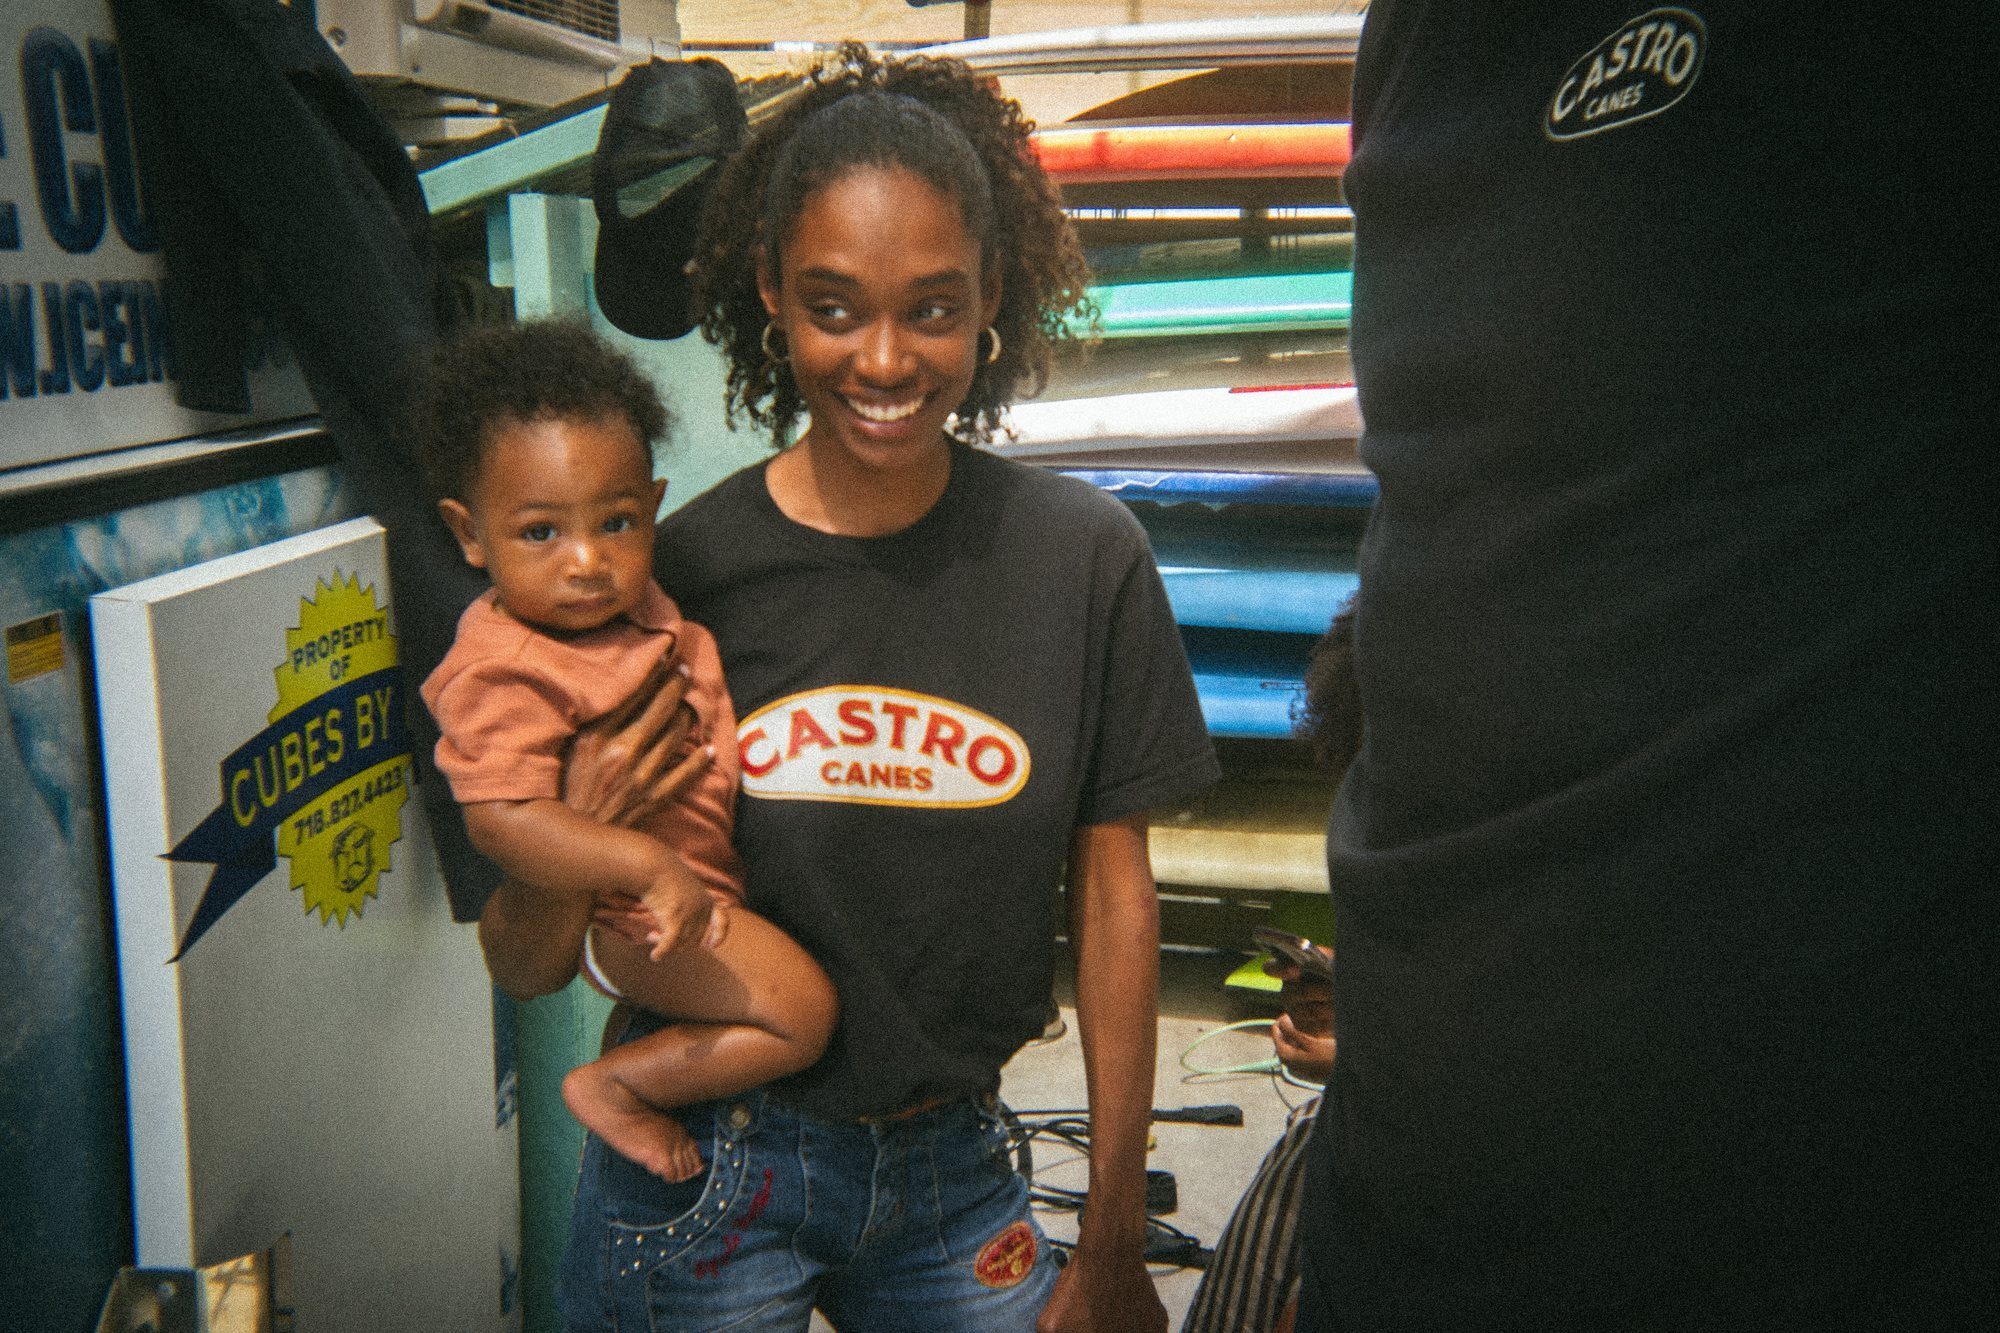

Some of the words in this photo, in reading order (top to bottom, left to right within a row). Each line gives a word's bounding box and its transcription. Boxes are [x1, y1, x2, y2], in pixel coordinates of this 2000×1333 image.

[1552, 22, 1698, 123] CASTRO
[1583, 82, 1645, 120] CANES
[292, 617, 385, 674] PROPERTY
[329, 654, 350, 680] OF
[231, 708, 344, 827] CUBES
[355, 687, 392, 749] BY
[739, 699, 1017, 786] CASTRO
[819, 760, 934, 791] CANES
